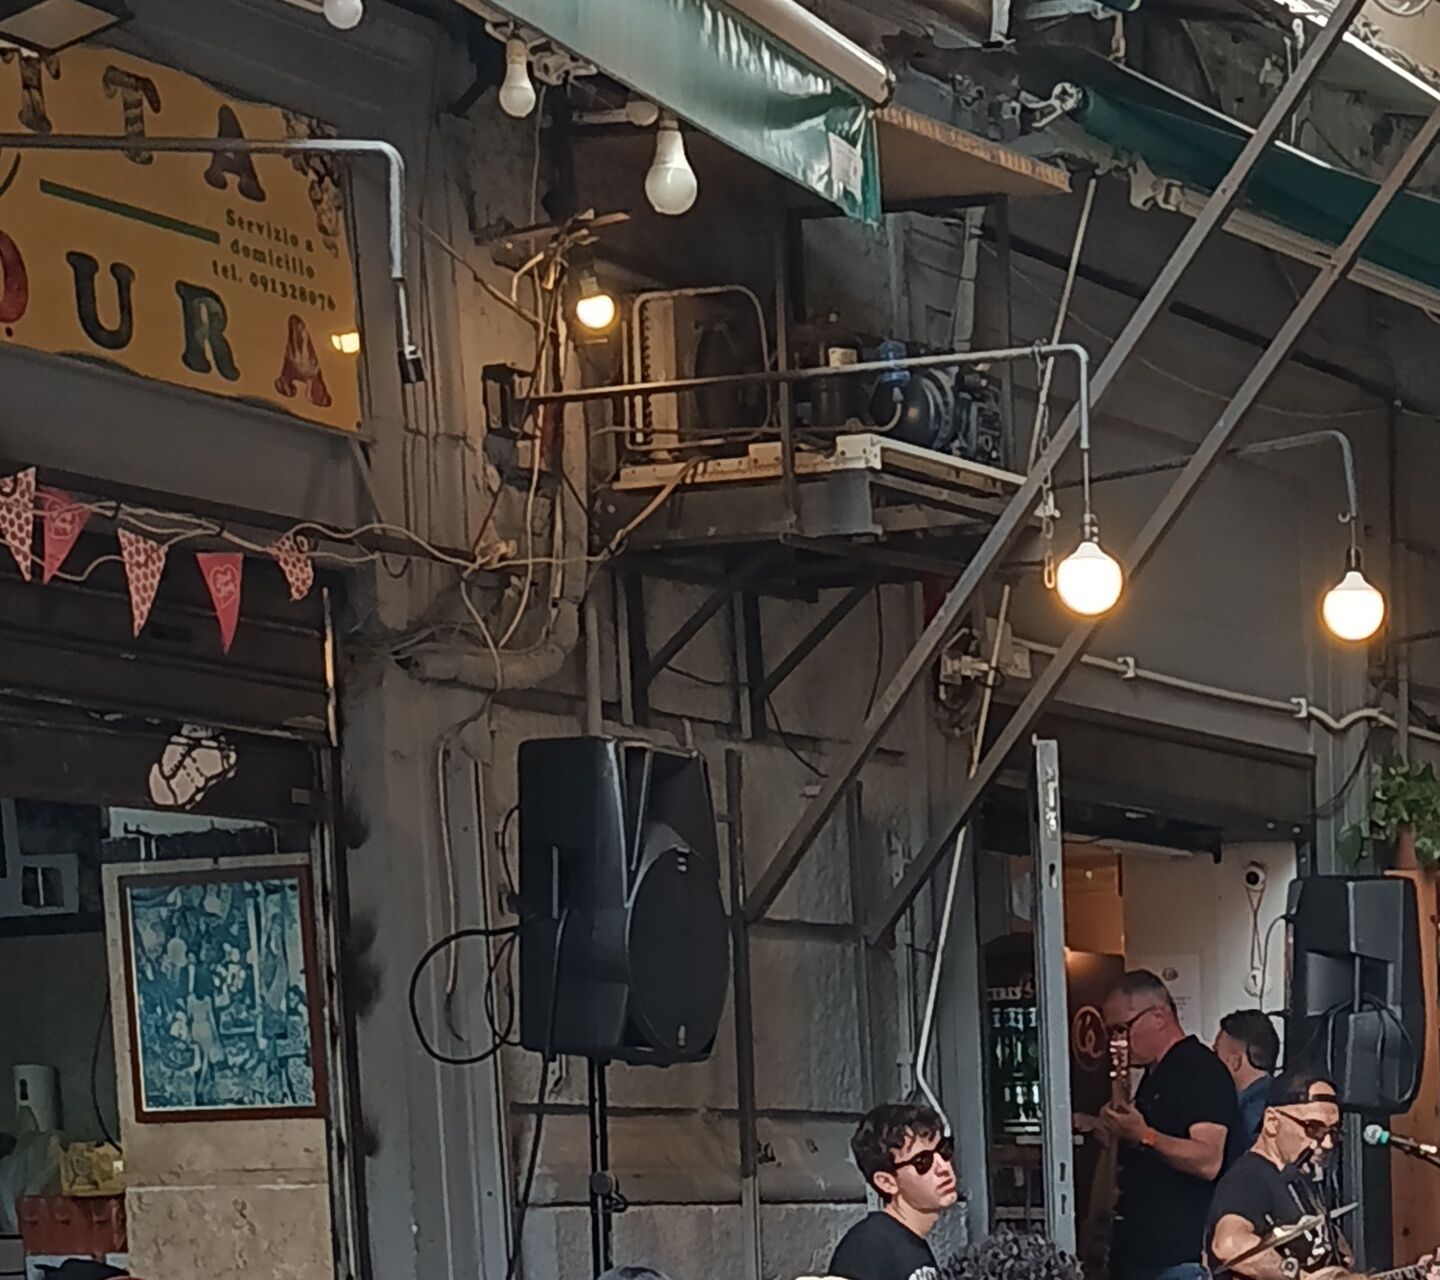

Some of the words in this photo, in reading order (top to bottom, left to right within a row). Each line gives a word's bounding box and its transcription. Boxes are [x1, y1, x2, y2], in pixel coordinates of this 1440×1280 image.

[225, 207, 299, 248] Servizio
[305, 239, 314, 253] a
[211, 259, 243, 284] tel.
[229, 238, 316, 280] domicilio
